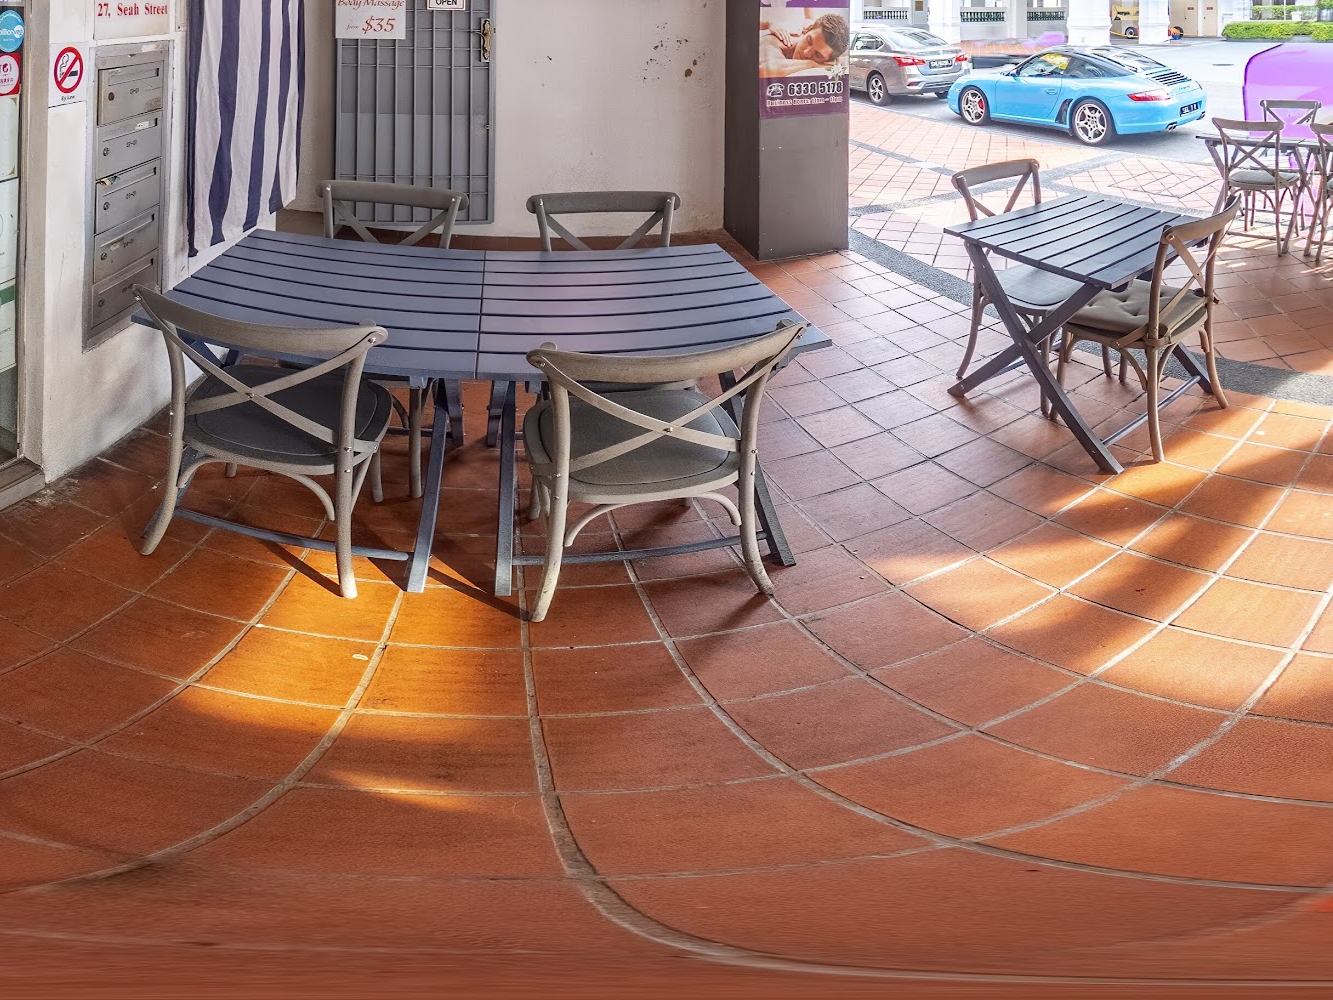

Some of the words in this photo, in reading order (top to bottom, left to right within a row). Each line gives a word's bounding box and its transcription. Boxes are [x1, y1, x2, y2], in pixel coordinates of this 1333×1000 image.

[97, 3, 111, 18] 27,
[117, 2, 140, 16] Seah
[144, 2, 168, 16] Street
[361, 15, 396, 34] $35
[788, 82, 817, 96] 6338
[819, 81, 843, 94] 5178
